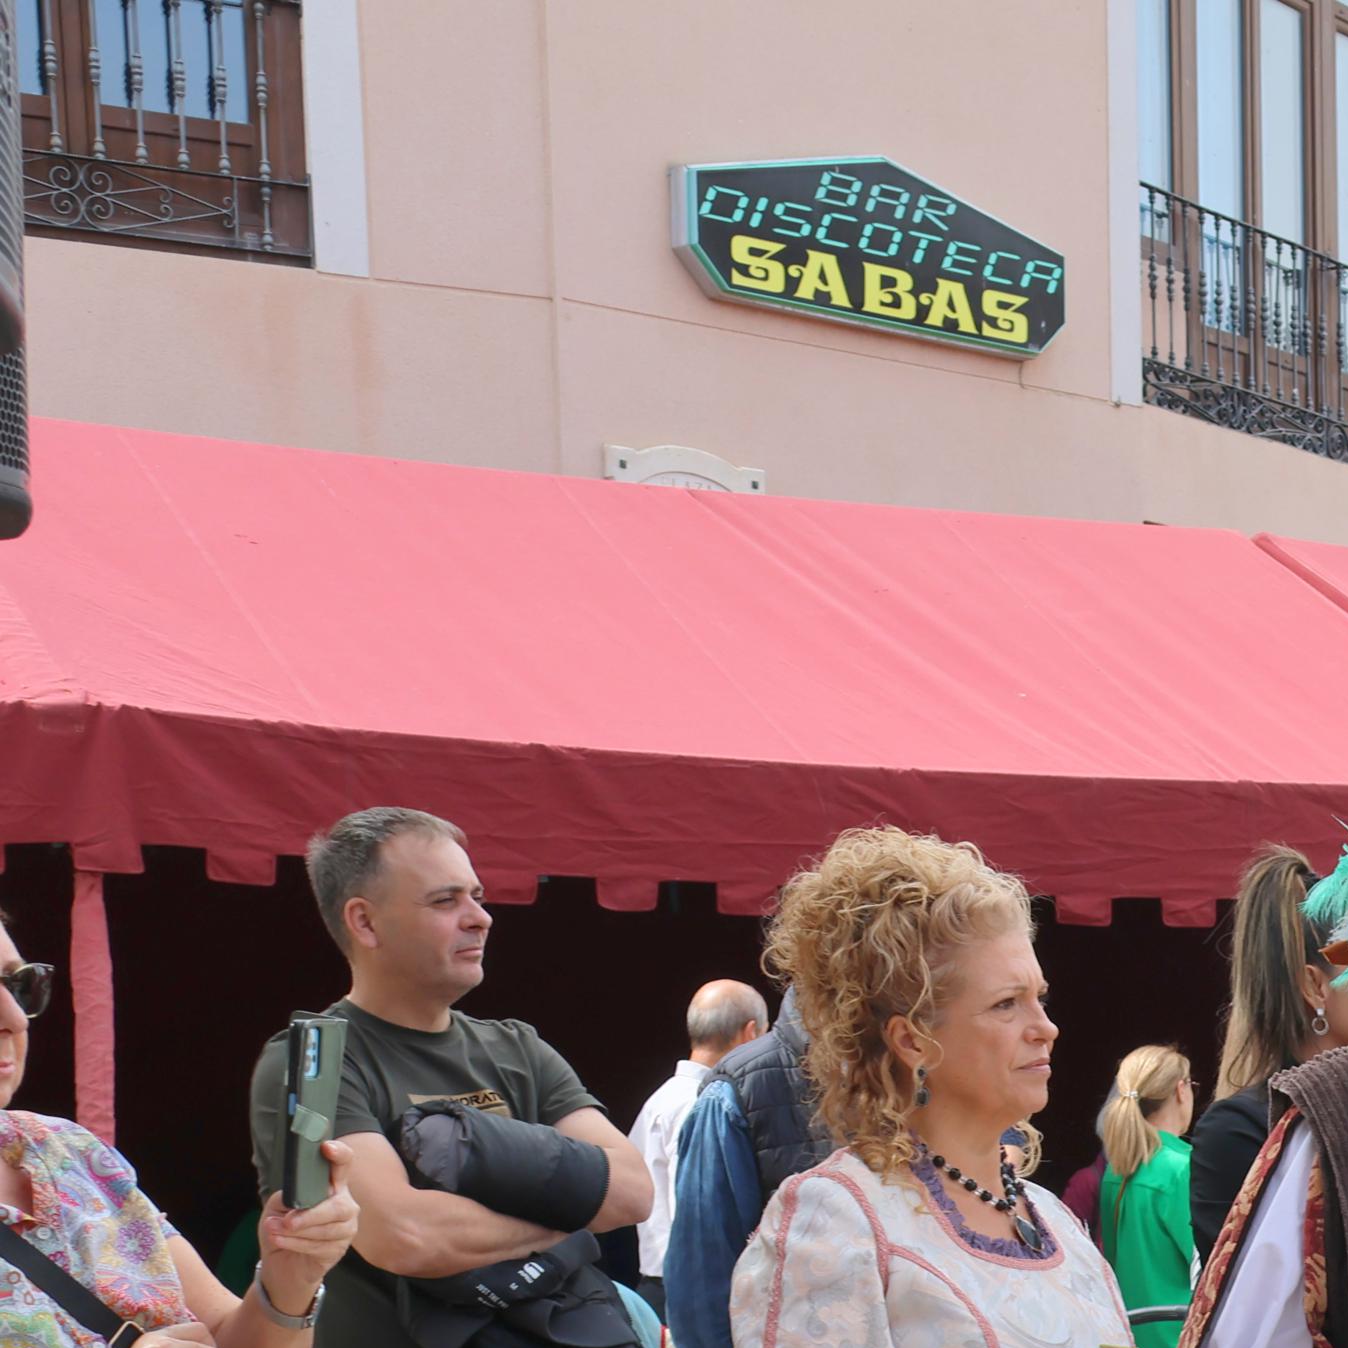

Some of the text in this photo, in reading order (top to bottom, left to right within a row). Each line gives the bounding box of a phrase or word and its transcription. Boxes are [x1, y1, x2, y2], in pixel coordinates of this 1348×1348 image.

[699, 185, 1062, 294] DISCOTECA
[814, 171, 957, 231] BAR
[731, 235, 1030, 344] SABAS
